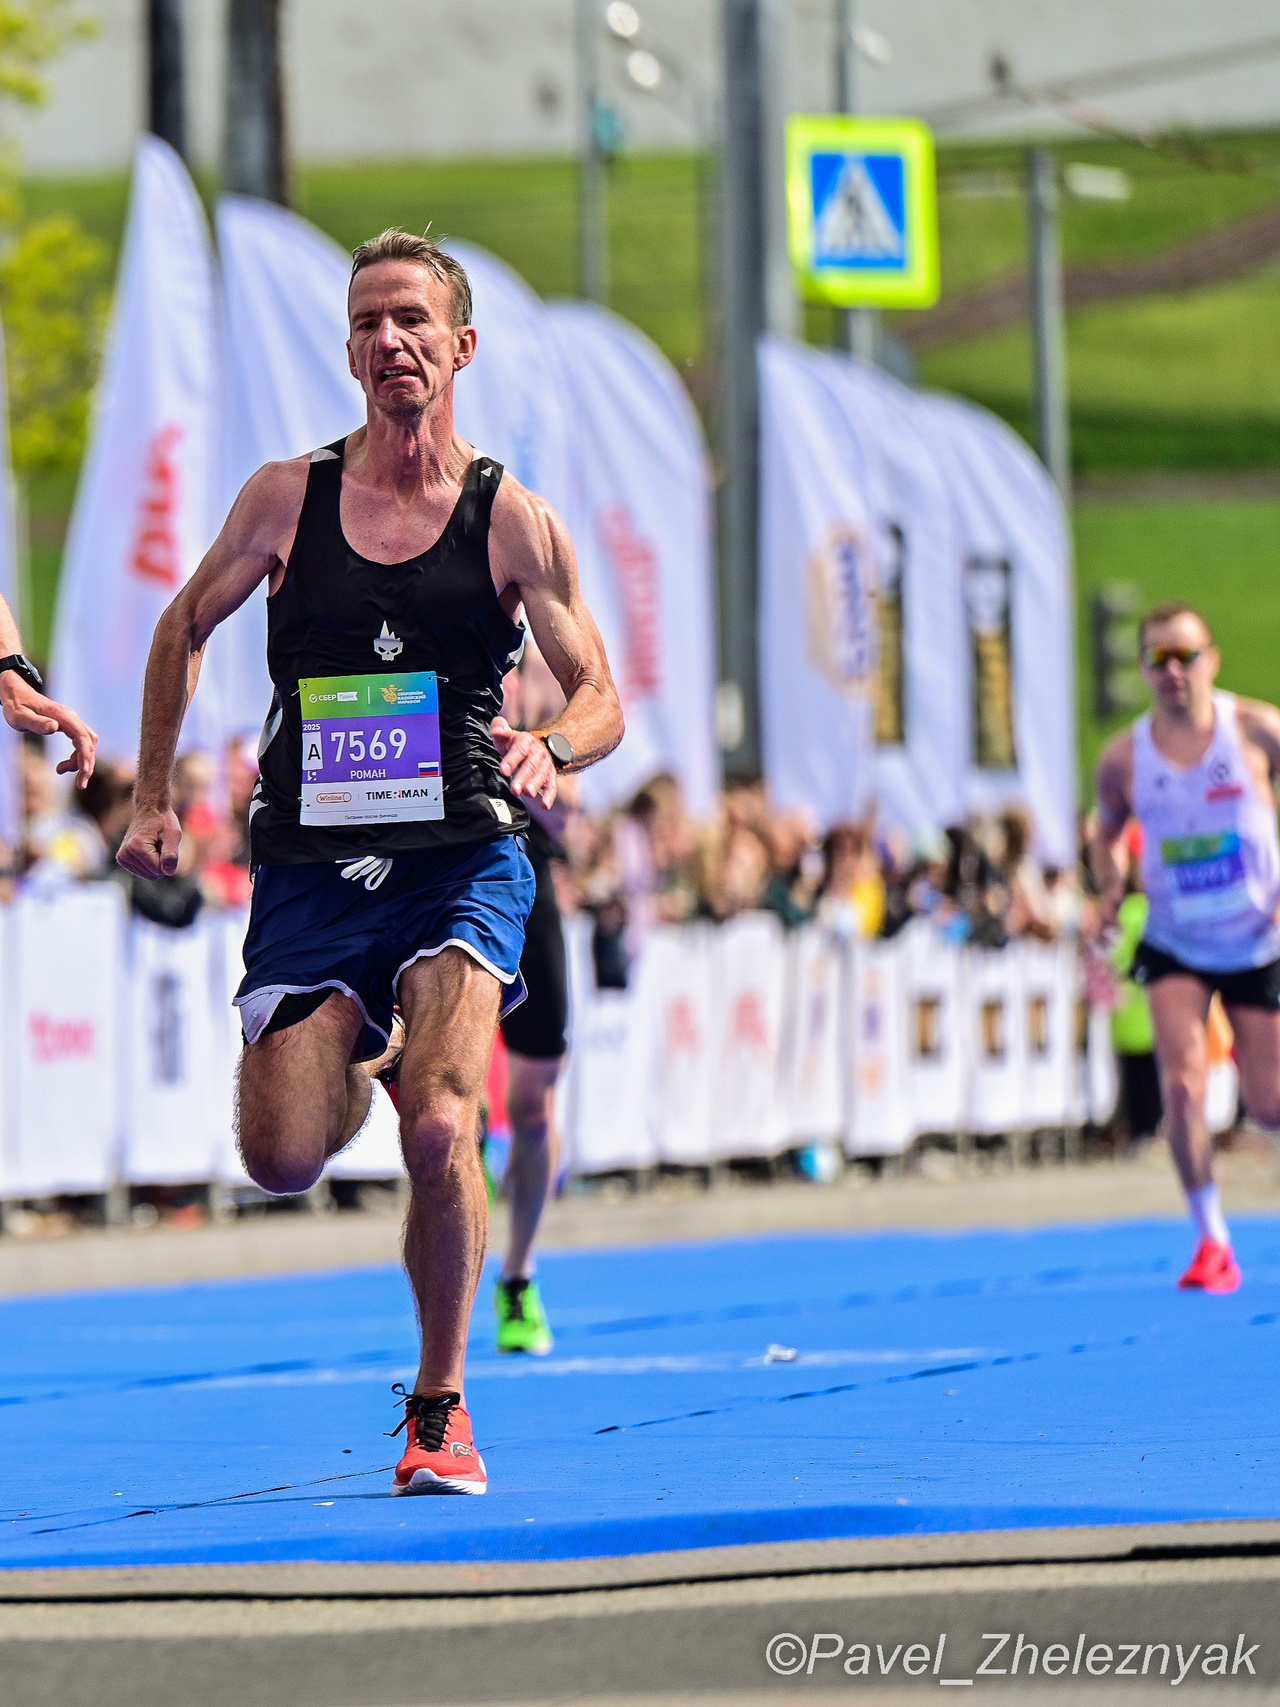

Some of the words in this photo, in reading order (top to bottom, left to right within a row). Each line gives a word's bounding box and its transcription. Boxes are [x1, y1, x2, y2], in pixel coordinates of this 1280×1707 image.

[302, 723, 321, 731] 2025
[330, 728, 407, 763] 7569
[350, 768, 386, 780] РОМАН
